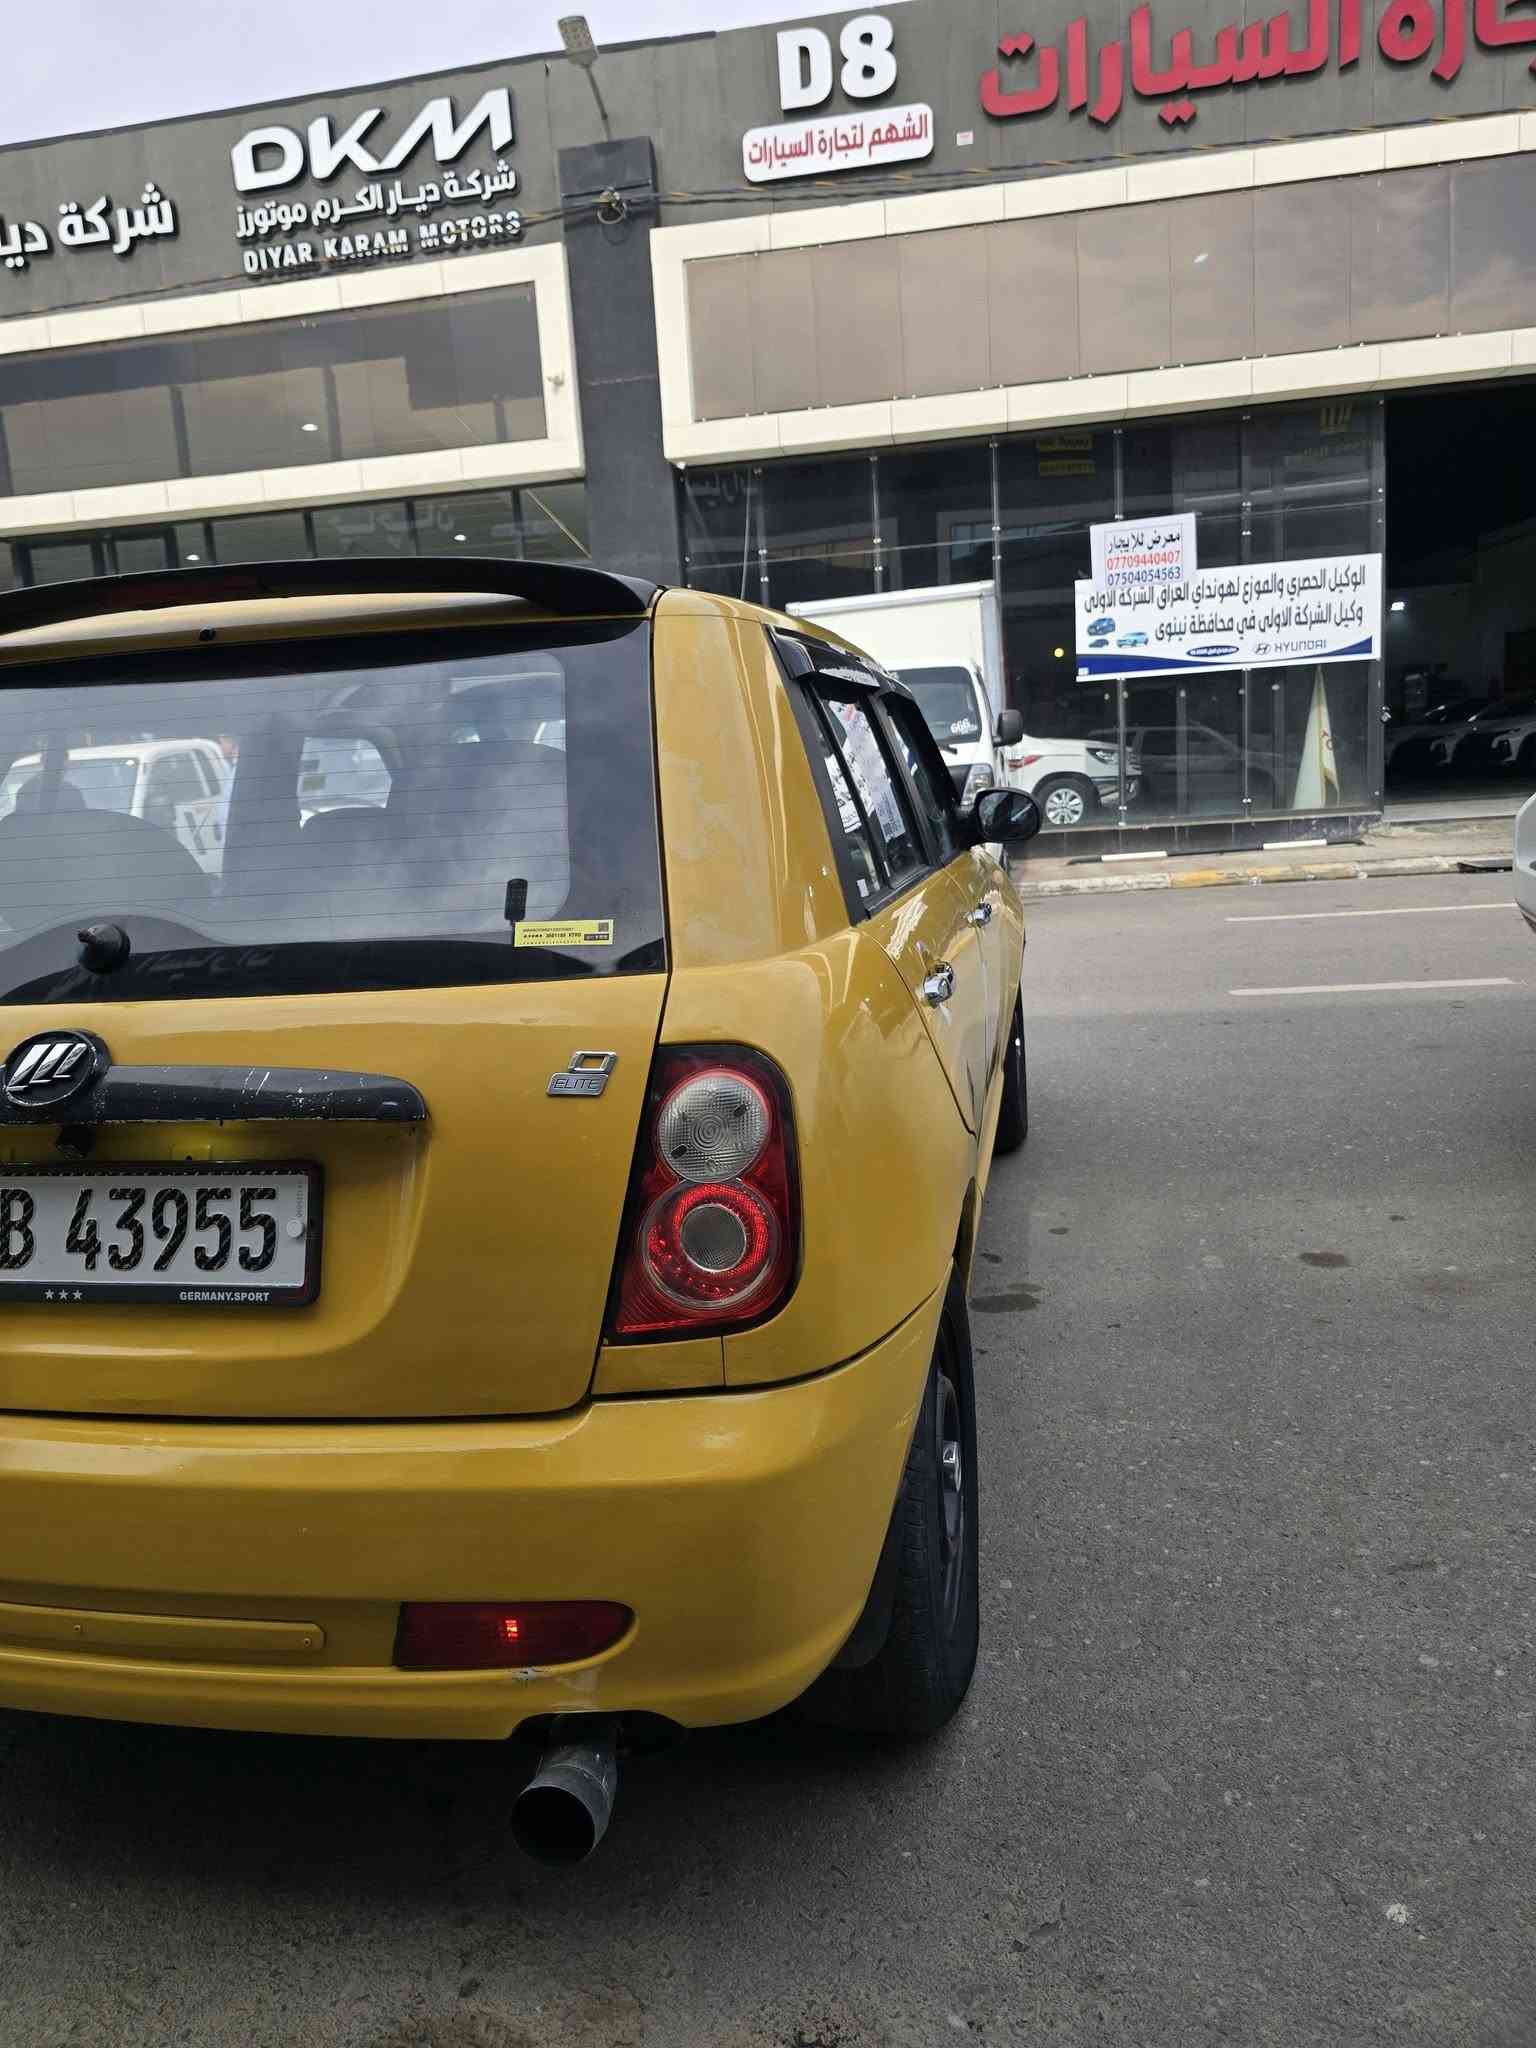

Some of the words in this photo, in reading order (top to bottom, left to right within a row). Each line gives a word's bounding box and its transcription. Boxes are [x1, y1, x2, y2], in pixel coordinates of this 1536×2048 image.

[777, 15, 897, 110] D8
[980, 0, 1360, 124] السيارات
[749, 130, 814, 168] السيارات
[818, 123, 864, 159] لتجارة
[869, 112, 928, 157] الشهم
[444, 159, 516, 201] شركة
[312, 184, 382, 226] الكرم
[386, 181, 441, 215] ديار
[58, 182, 174, 254] شركة
[236, 201, 307, 238] موتورز
[0, 221, 48, 268] دي
[244, 242, 312, 273] DIYAR
[324, 229, 408, 258] KARAM
[419, 210, 521, 248] MOTORS
[1147, 529, 1180, 550] معرض
[1157, 582, 1189, 610] العراق
[1192, 576, 1240, 609] لهونداي
[1242, 572, 1284, 604] والموزع
[1287, 568, 1326, 601] الحصري
[1329, 564, 1366, 594] الوكيل
[1189, 612, 1234, 634] محافظة
[1295, 601, 1332, 631] الشركة
[1334, 600, 1363, 628] وكيل
[1274, 639, 1327, 653] HYUNDAI
[554, 1078, 600, 1089] ELITE
[0, 1188, 34, 1269] B
[66, 1187, 276, 1271] 43955
[180, 1291, 270, 1302] GERMANY.SPORT
